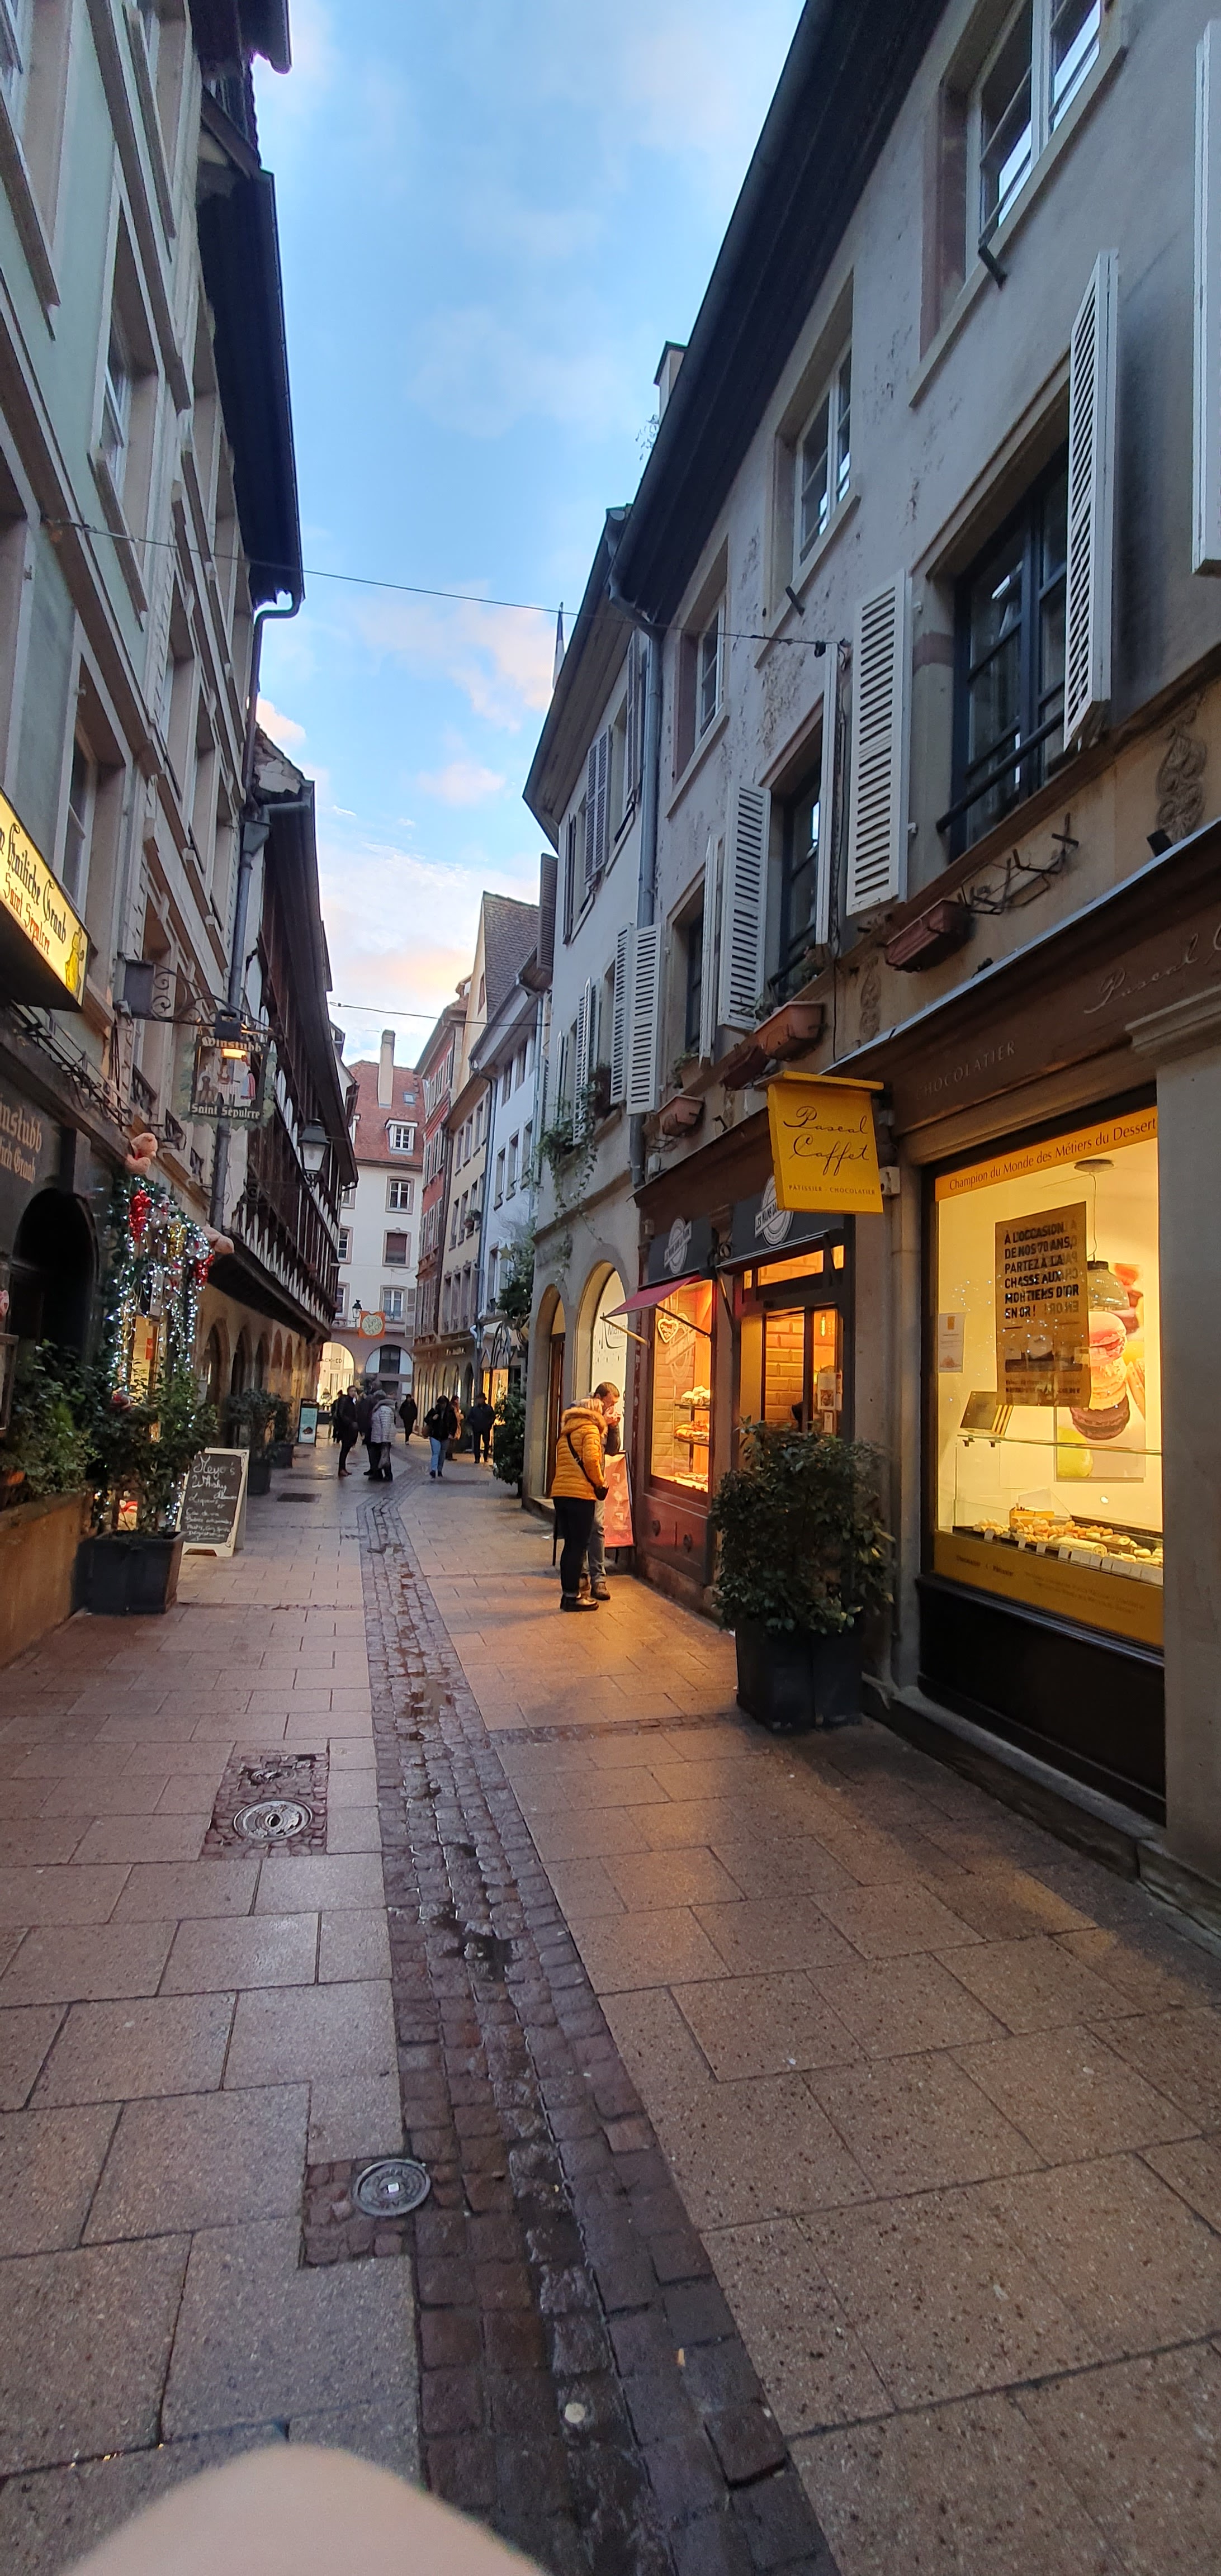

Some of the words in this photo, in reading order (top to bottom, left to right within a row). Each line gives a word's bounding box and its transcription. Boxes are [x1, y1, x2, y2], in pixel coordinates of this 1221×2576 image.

[3, 872, 23, 918] Saint
[1083, 932, 1199, 1015] Pascal
[201, 1035, 262, 1052] Winstubb
[916, 1040, 1015, 1100] CHOCOLATIER
[191, 1103, 217, 1115] Saint
[783, 1106, 868, 1134] Pascal
[0, 1093, 42, 1153] instubb
[789, 1134, 869, 1176] Caffet
[949, 1171, 988, 1191] Champion
[990, 1166, 1001, 1178] du
[1003, 1156, 1034, 1175] Monde
[1037, 1150, 1052, 1164] des
[1055, 1139, 1092, 1158] Métiers
[1095, 1131, 1110, 1147] du
[1113, 1117, 1156, 1142] Dessert
[830, 1187, 875, 1195] CHOCOLATIER
[1004, 1230, 1011, 1245] À
[1012, 1222, 1064, 1243] L'OCCASION
[1005, 1247, 1016, 1259] DE
[1018, 1244, 1036, 1258] NOS
[1038, 1241, 1048, 1253] 70
[1050, 1236, 1072, 1251] ANS,
[1005, 1258, 1039, 1274] PARTEZ
[1005, 1273, 1040, 1289] CHASSE
[1042, 1270, 1061, 1284] AUX
[1056, 1284, 1079, 1298] D'OR
[1005, 1307, 1018, 1319] EN
[1020, 1305, 1030, 1317] OR
